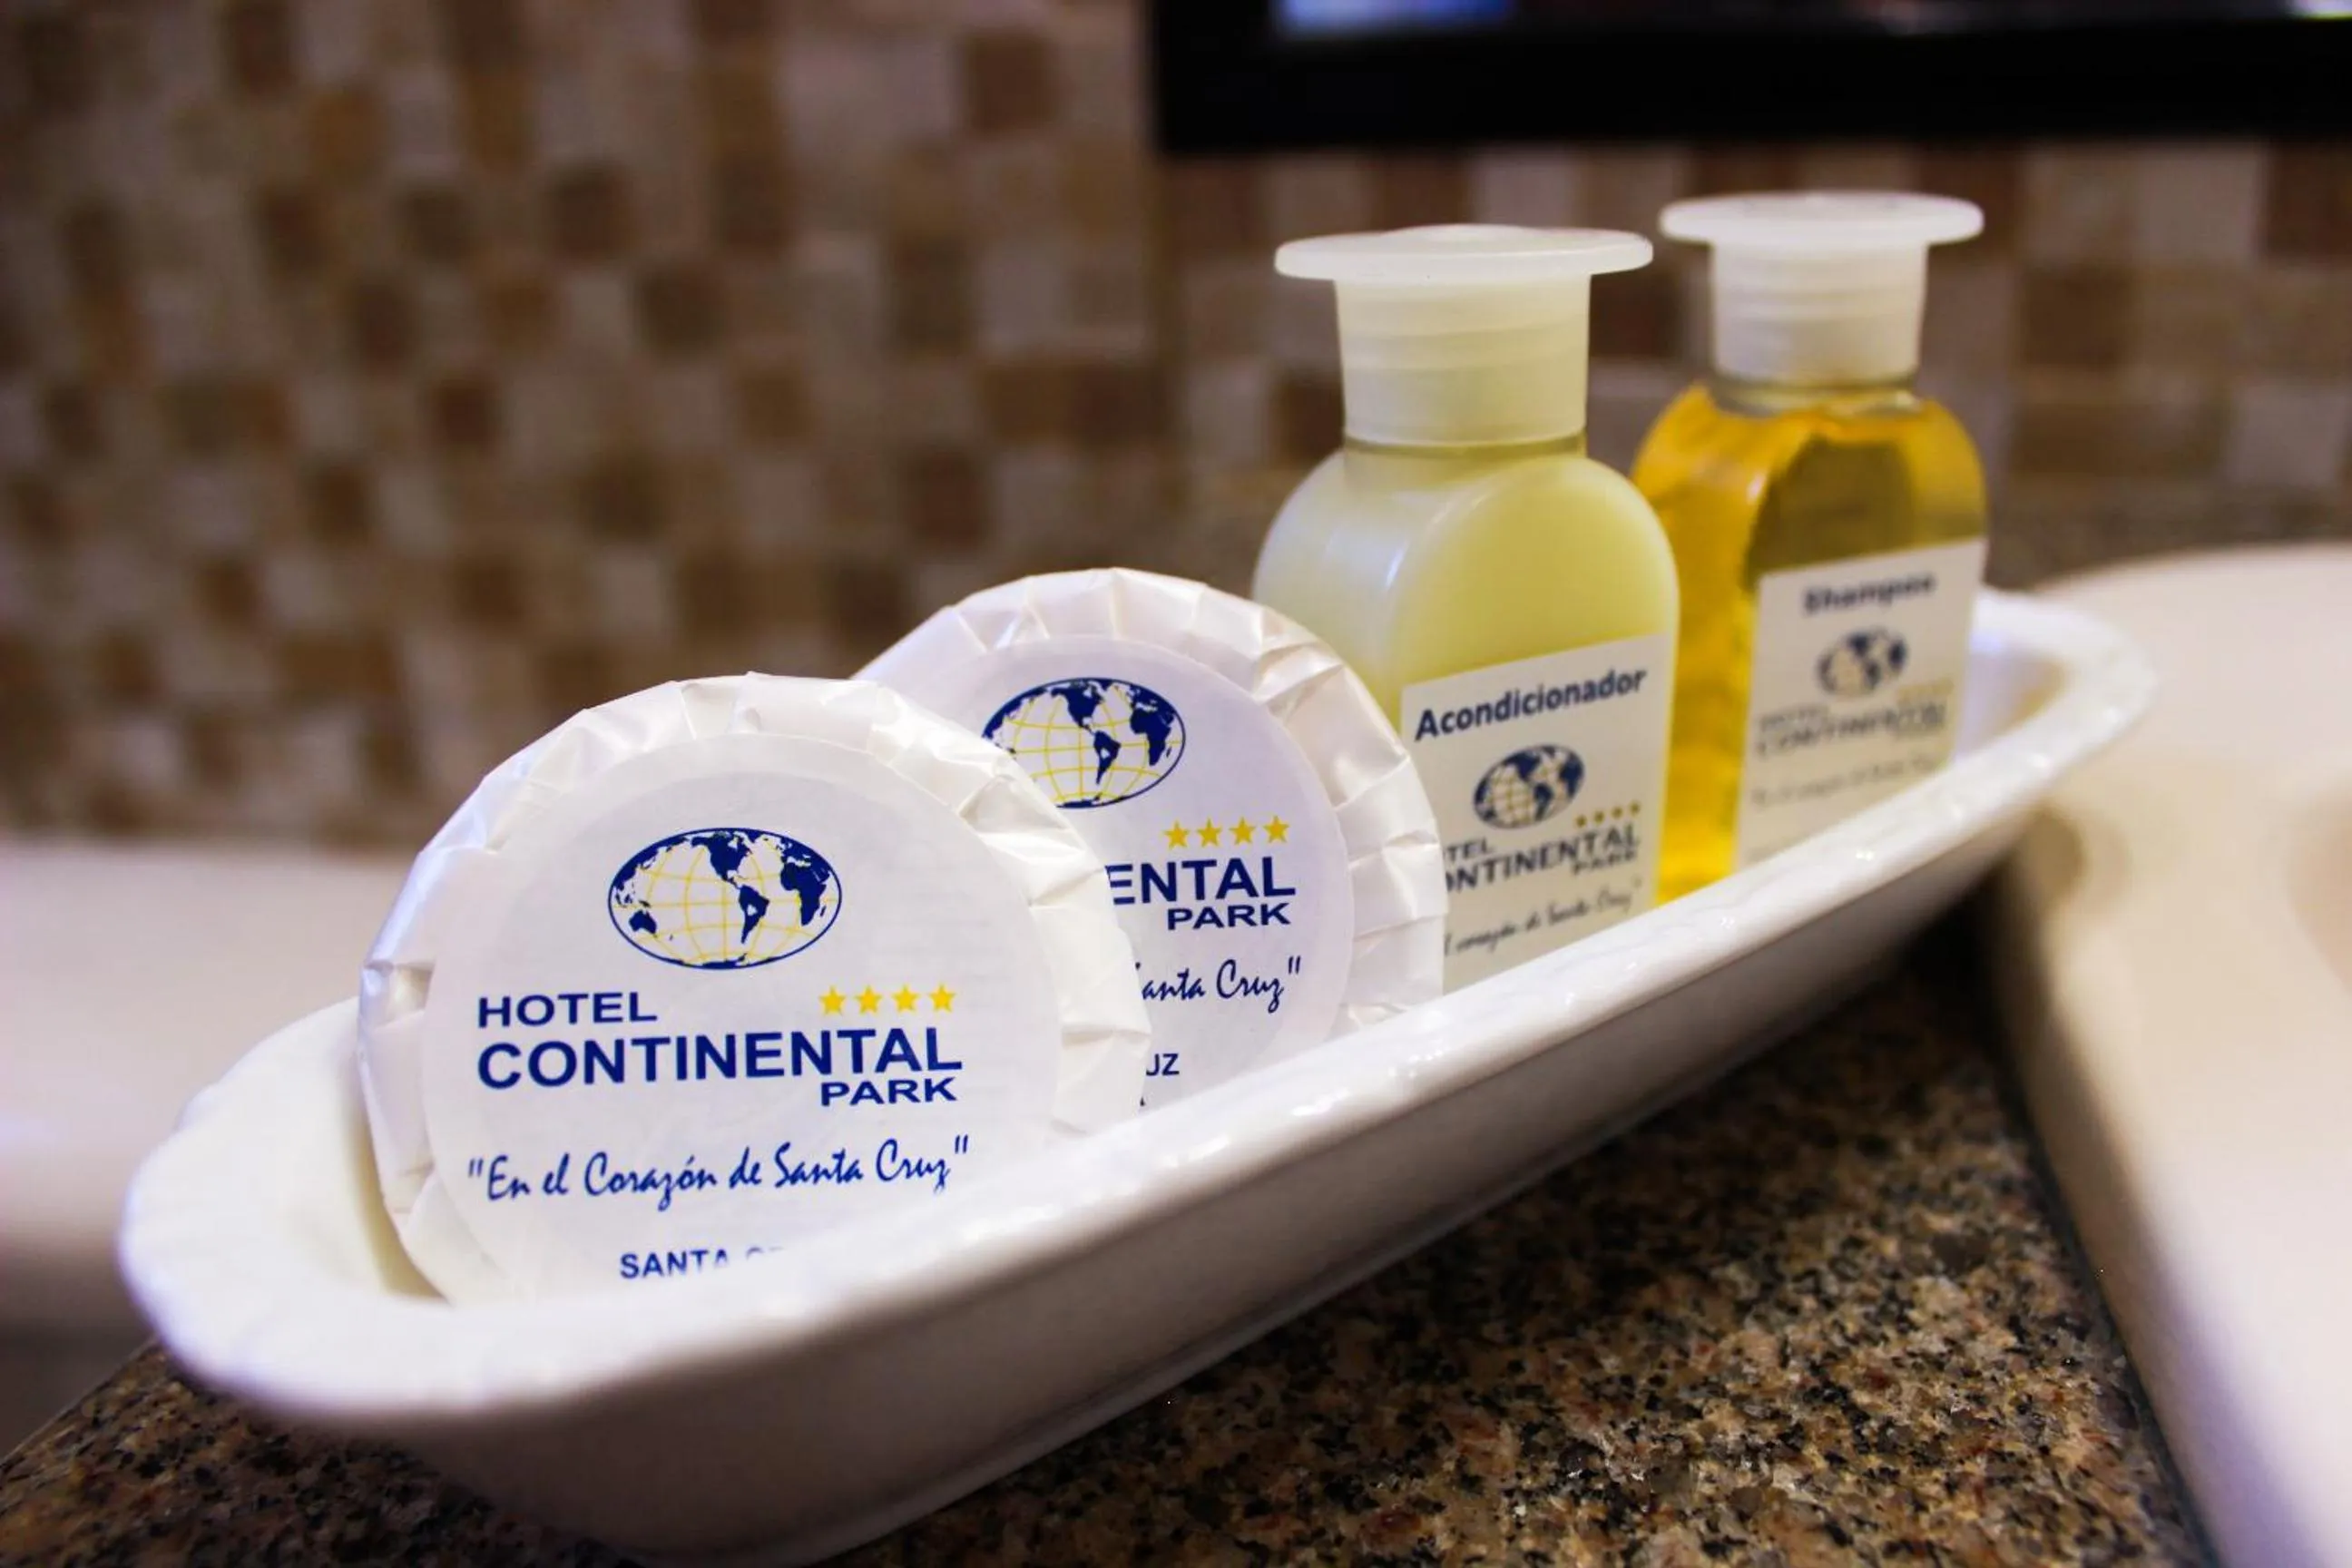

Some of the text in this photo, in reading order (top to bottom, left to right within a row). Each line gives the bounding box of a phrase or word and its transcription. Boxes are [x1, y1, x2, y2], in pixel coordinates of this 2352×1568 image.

[1415, 670, 1647, 742] Acondicionador
[1443, 838, 1496, 863] TEL
[1168, 903, 1291, 931] PARK
[1134, 962, 1206, 1001] anta
[477, 992, 658, 1029] HOTEL
[477, 1027, 963, 1090] CONTINENTAL
[820, 1077, 957, 1108] PARK
[542, 1153, 570, 1197] el
[583, 1152, 718, 1211] Corazón
[729, 1146, 762, 1191] de
[775, 1142, 864, 1189] Santa
